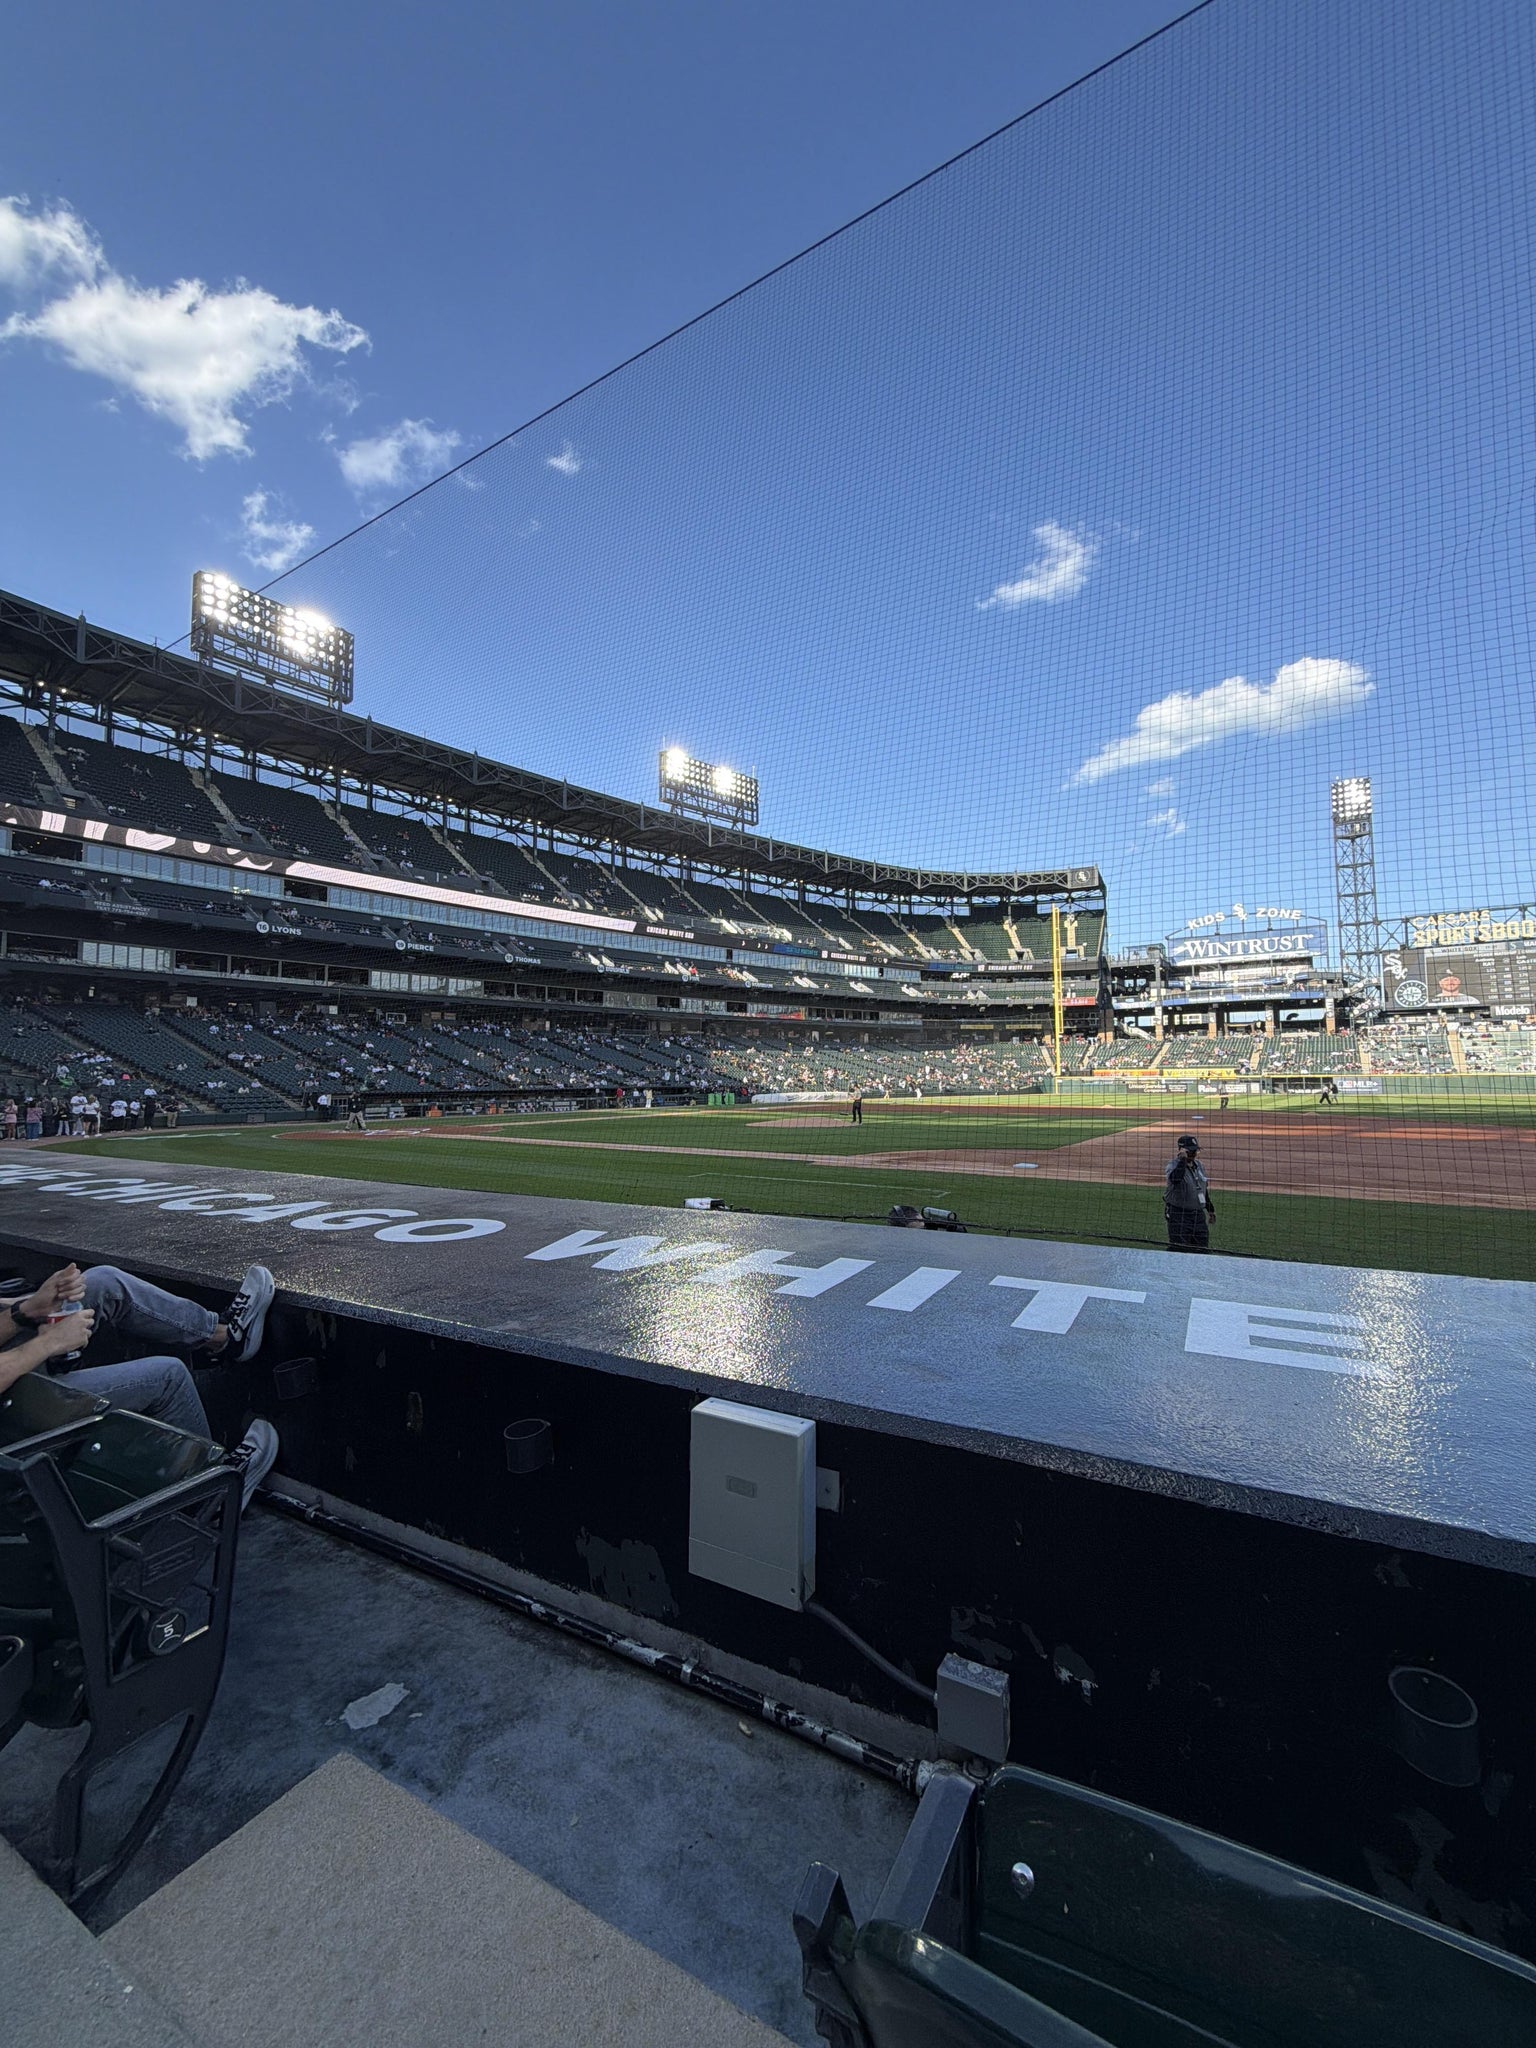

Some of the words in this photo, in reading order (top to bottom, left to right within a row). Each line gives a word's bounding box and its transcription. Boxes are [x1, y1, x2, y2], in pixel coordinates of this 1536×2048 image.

[1188, 912, 1225, 929] KIDS
[1256, 908, 1302, 919] ZONE
[1413, 910, 1490, 927] CAESARS
[271, 925, 302, 936] LYONS
[407, 942, 434, 952] PIERCE
[515, 956, 541, 964] THOMAS
[1495, 1005, 1530, 1016] Modelo
[37, 1178, 506, 1243] CHICAGO
[524, 1230, 1385, 1379] WHITE
